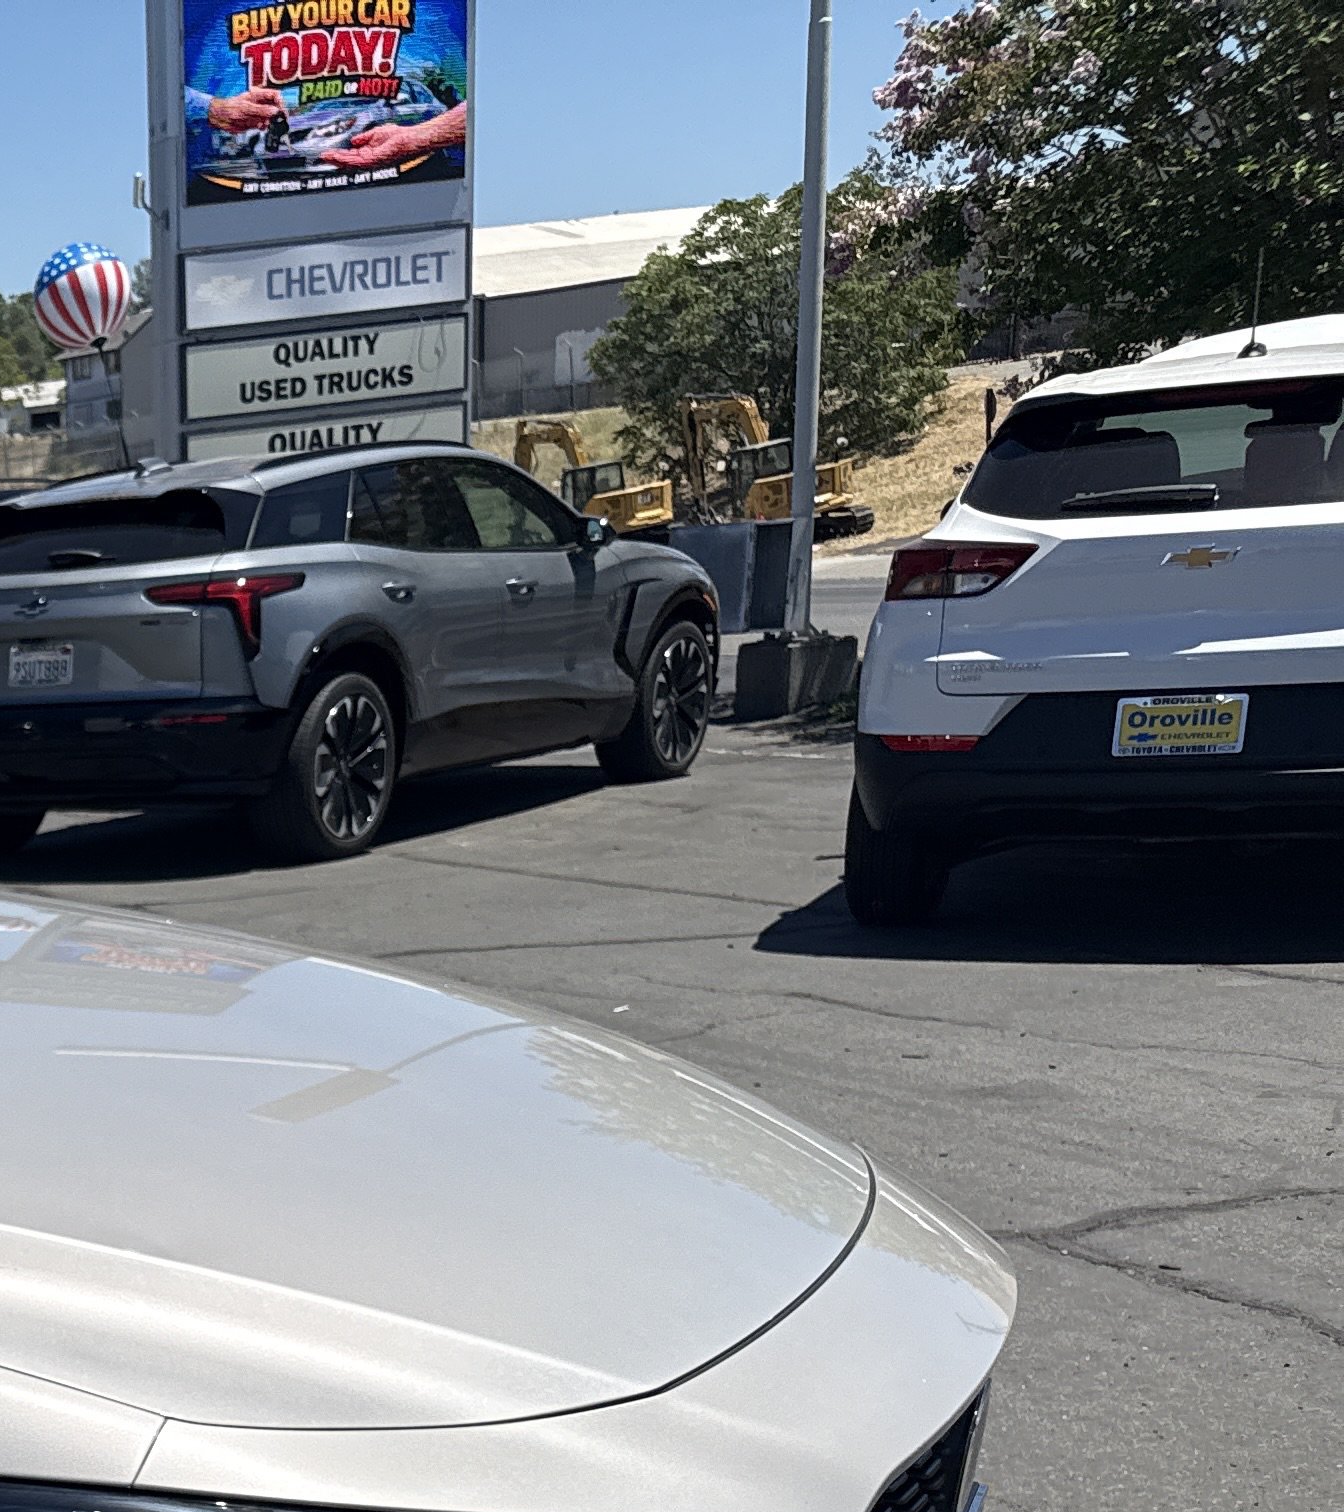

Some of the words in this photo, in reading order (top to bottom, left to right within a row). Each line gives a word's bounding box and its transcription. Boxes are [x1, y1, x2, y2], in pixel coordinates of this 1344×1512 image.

[232, 6, 284, 44] BUY
[287, 0, 354, 29] YOUR
[357, 0, 411, 28] CAR
[242, 28, 399, 88] TODAY!
[301, 80, 343, 101] PAID
[359, 77, 400, 97] NOT!
[266, 251, 450, 300] CHEVROLET
[273, 332, 379, 367] QUALITY
[239, 375, 307, 404] USED
[314, 364, 414, 396] TRUCKS
[1152, 696, 1212, 705] OROVILLE
[1128, 708, 1233, 728] Oroville
[1132, 746, 1163, 754] TOYOTA
[1169, 745, 1217, 753] CHEVROLET
[1160, 731, 1232, 740] CHEVROLET
